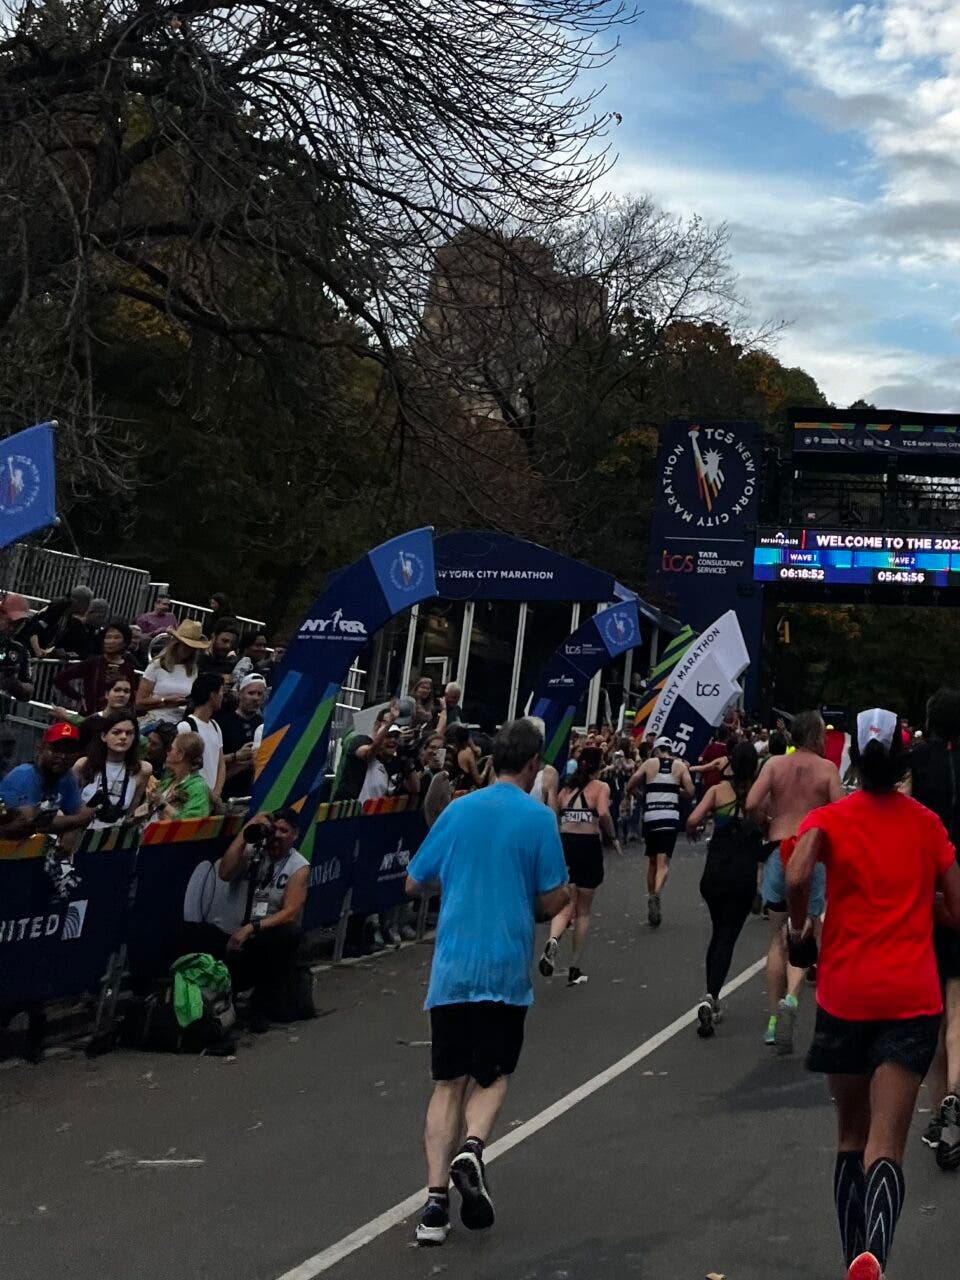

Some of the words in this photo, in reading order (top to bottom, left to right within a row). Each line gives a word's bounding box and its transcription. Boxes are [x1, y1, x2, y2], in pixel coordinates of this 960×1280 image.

[705, 429, 735, 444] TCS
[735, 441, 757, 472] NEW
[663, 444, 694, 523] MARATHON
[732, 477, 756, 516] YORK
[696, 513, 730, 527] CITY
[816, 535, 884, 548] WELCOME
[885, 537, 904, 549] TO
[906, 538, 932, 549] THE
[698, 551, 718, 559] TATA
[790, 553, 813, 562] WAVE
[888, 557, 909, 565] WAVE
[910, 557, 916, 565] 2
[662, 550, 694, 573] tcs
[697, 559, 744, 568] CONSULTANCY
[449, 570, 475, 579] YORK
[476, 570, 499, 579] CITY
[500, 570, 554, 580] MARATHON
[696, 566, 727, 575] SERVICES
[780, 569, 825, 580] 06:18:52
[877, 571, 925, 582] 05:43:56
[565, 643, 581, 654] tcs
[663, 681, 679, 709] CITY
[677, 627, 721, 681] MARATHON
[697, 681, 720, 697] tcs
